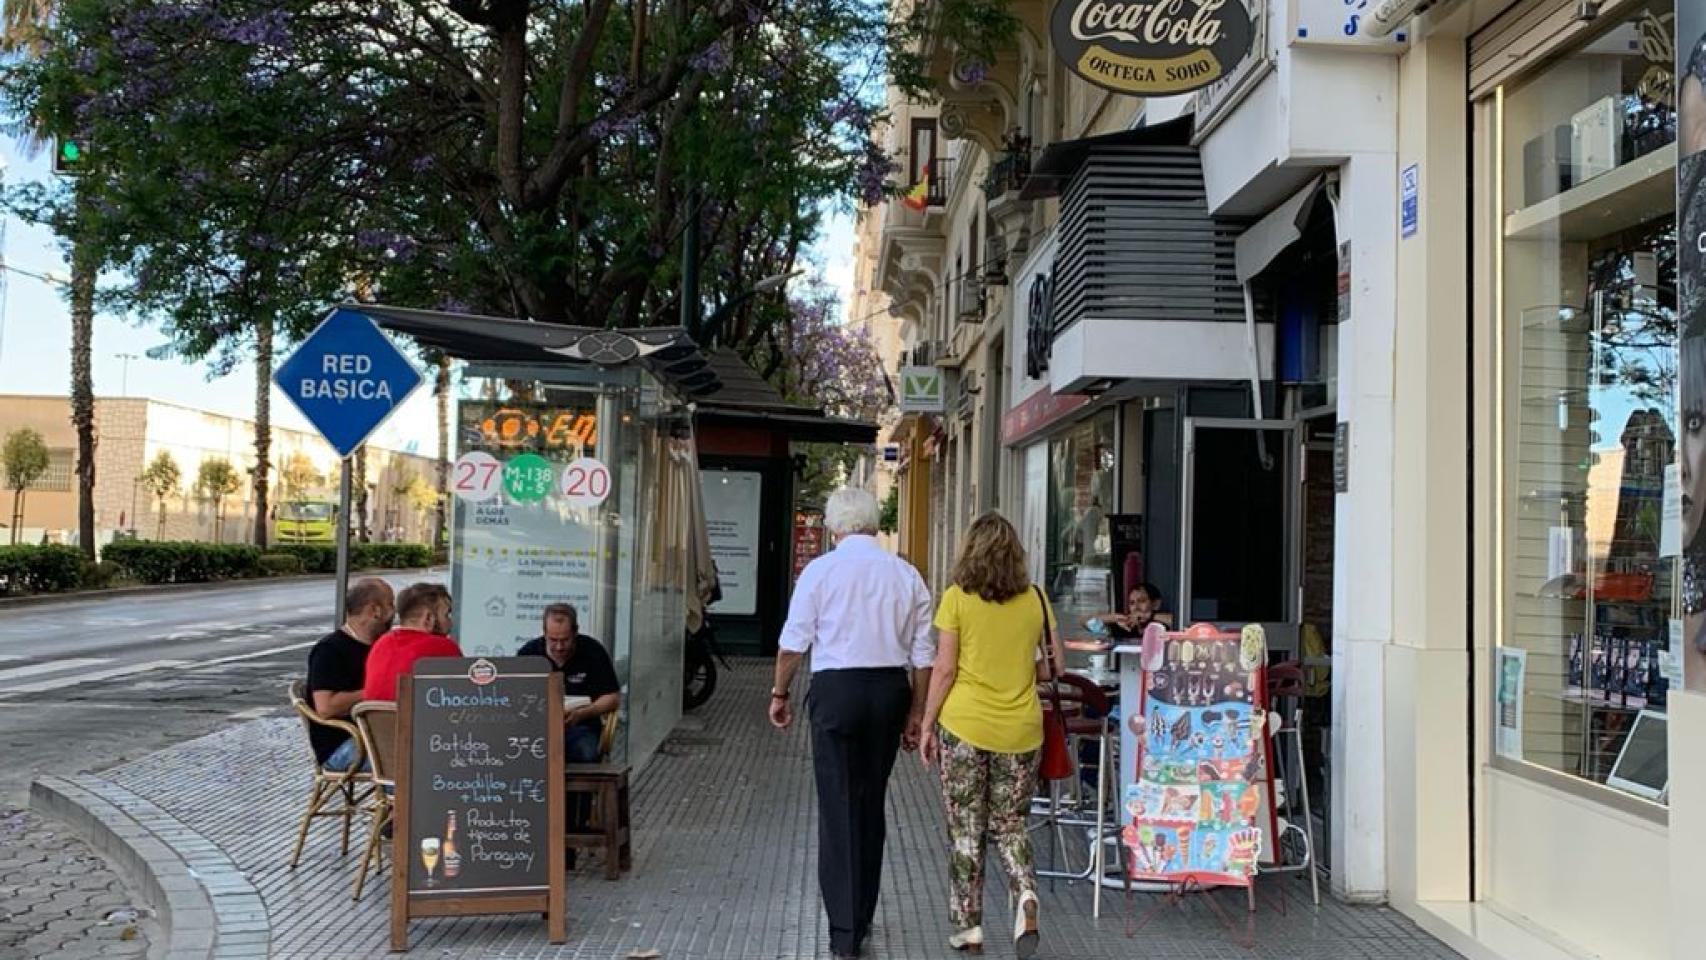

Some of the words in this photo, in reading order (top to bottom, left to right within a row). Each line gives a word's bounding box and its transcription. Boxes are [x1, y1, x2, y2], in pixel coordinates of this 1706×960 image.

[1089, 56, 1156, 82] ORTEGA
[1166, 60, 1211, 82] SOHO
[322, 354, 372, 374] RED
[456, 462, 498, 490] 27
[506, 467, 551, 482] M-138
[567, 467, 608, 496] 20
[426, 686, 511, 707] Chocolate
[430, 732, 490, 752] Batidos
[432, 773, 506, 791] Bocadillos
[467, 807, 531, 827] Productos
[471, 844, 535, 872] Paraguay
